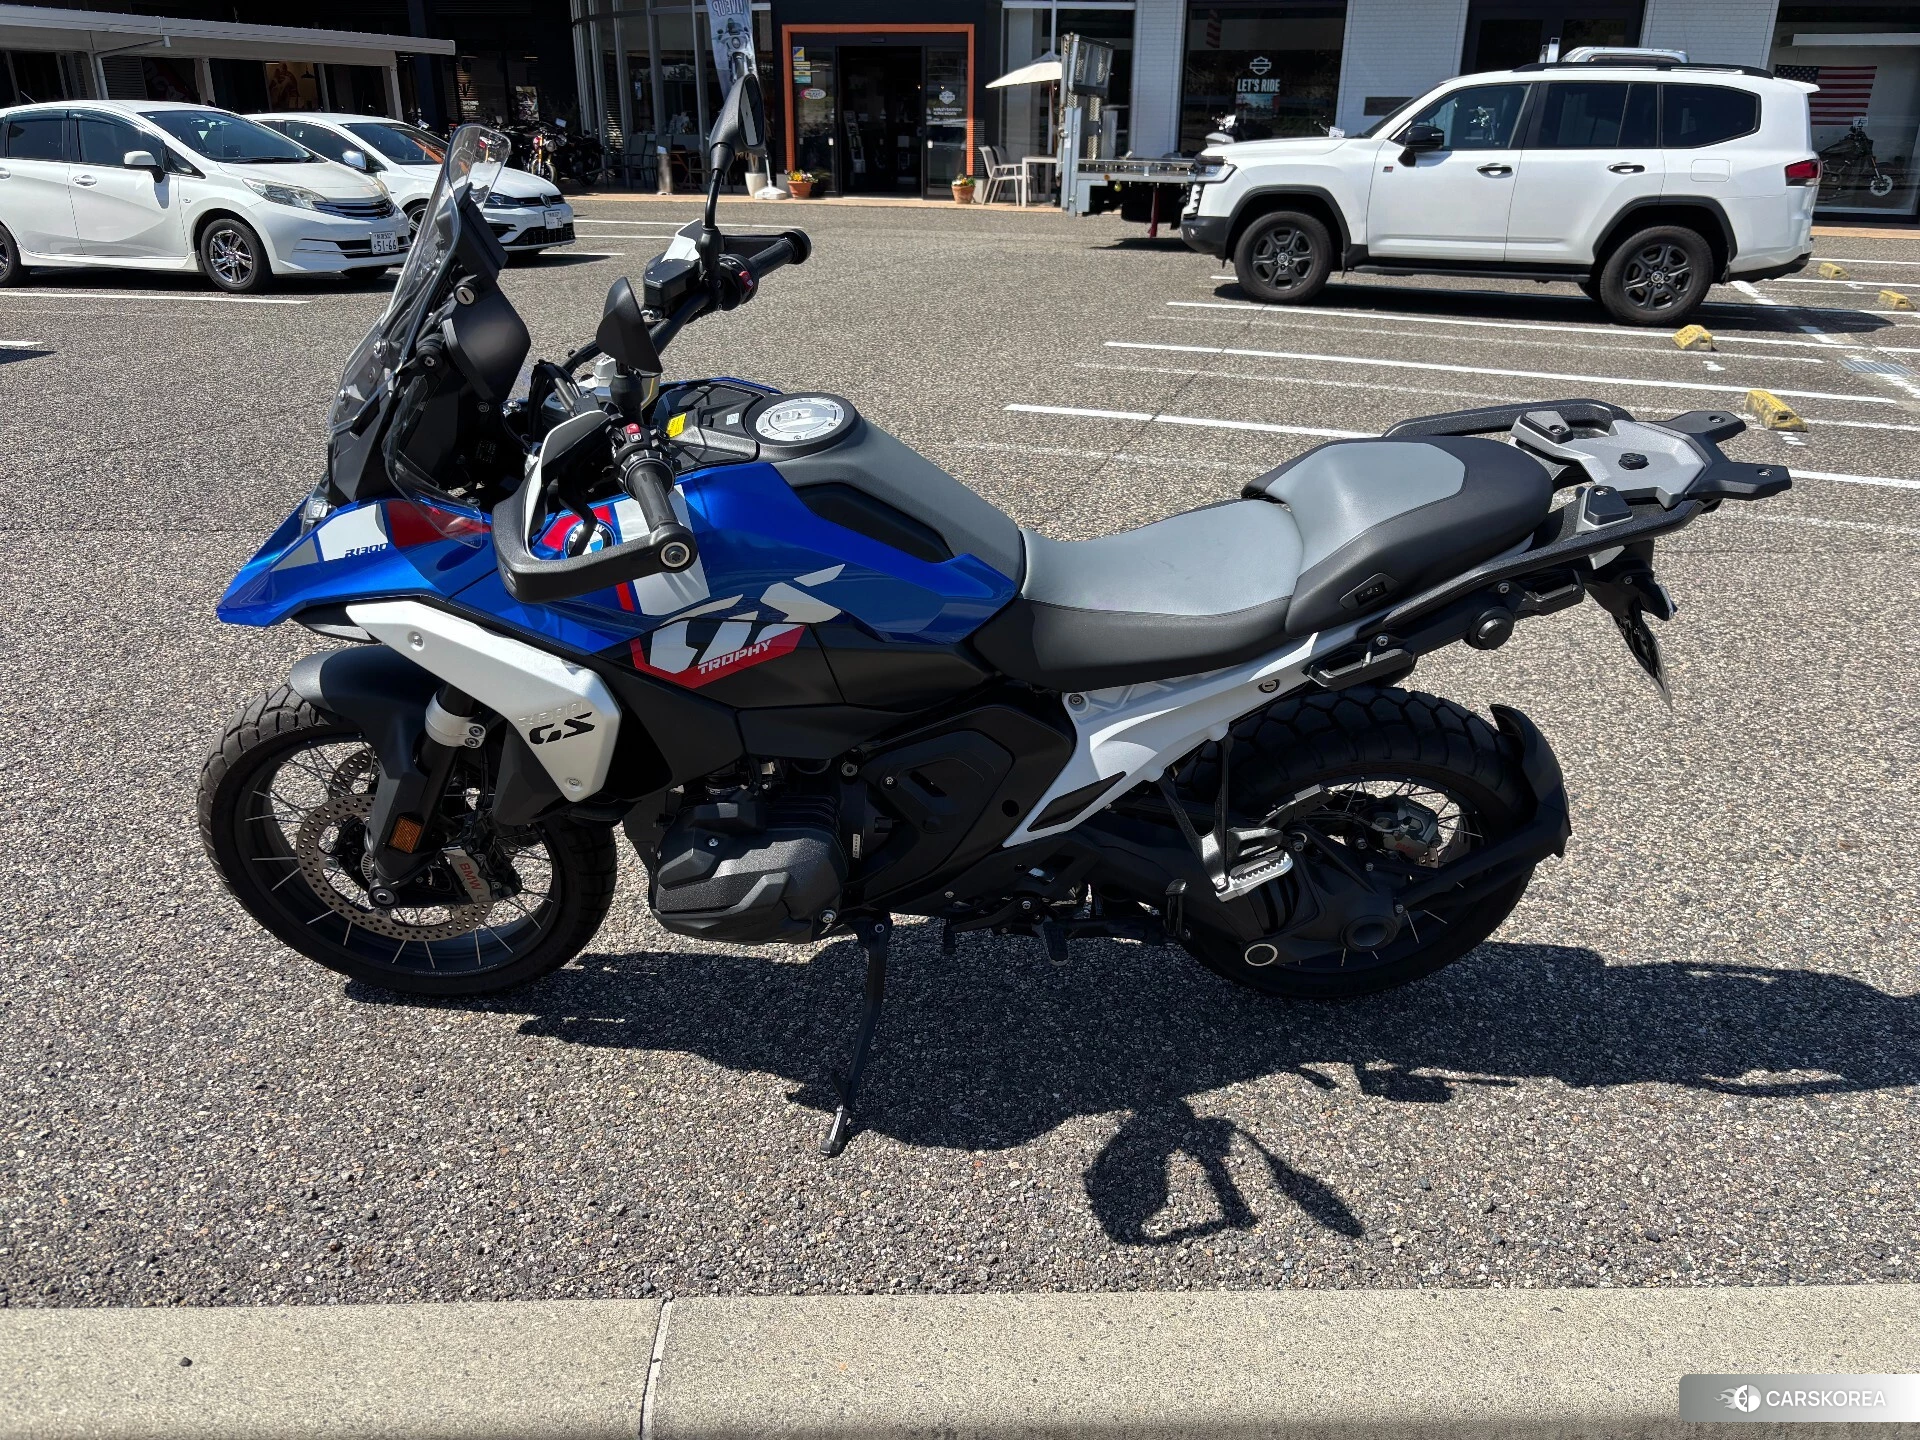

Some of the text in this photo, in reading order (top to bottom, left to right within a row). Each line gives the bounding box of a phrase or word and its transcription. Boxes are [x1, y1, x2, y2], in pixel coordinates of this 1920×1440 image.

[1236, 78, 1280, 92] LET'S RIDE
[376, 239, 397, 252] 51-66
[697, 640, 772, 675] TROPHY
[528, 711, 596, 745] GS
[459, 862, 483, 890] BMW
